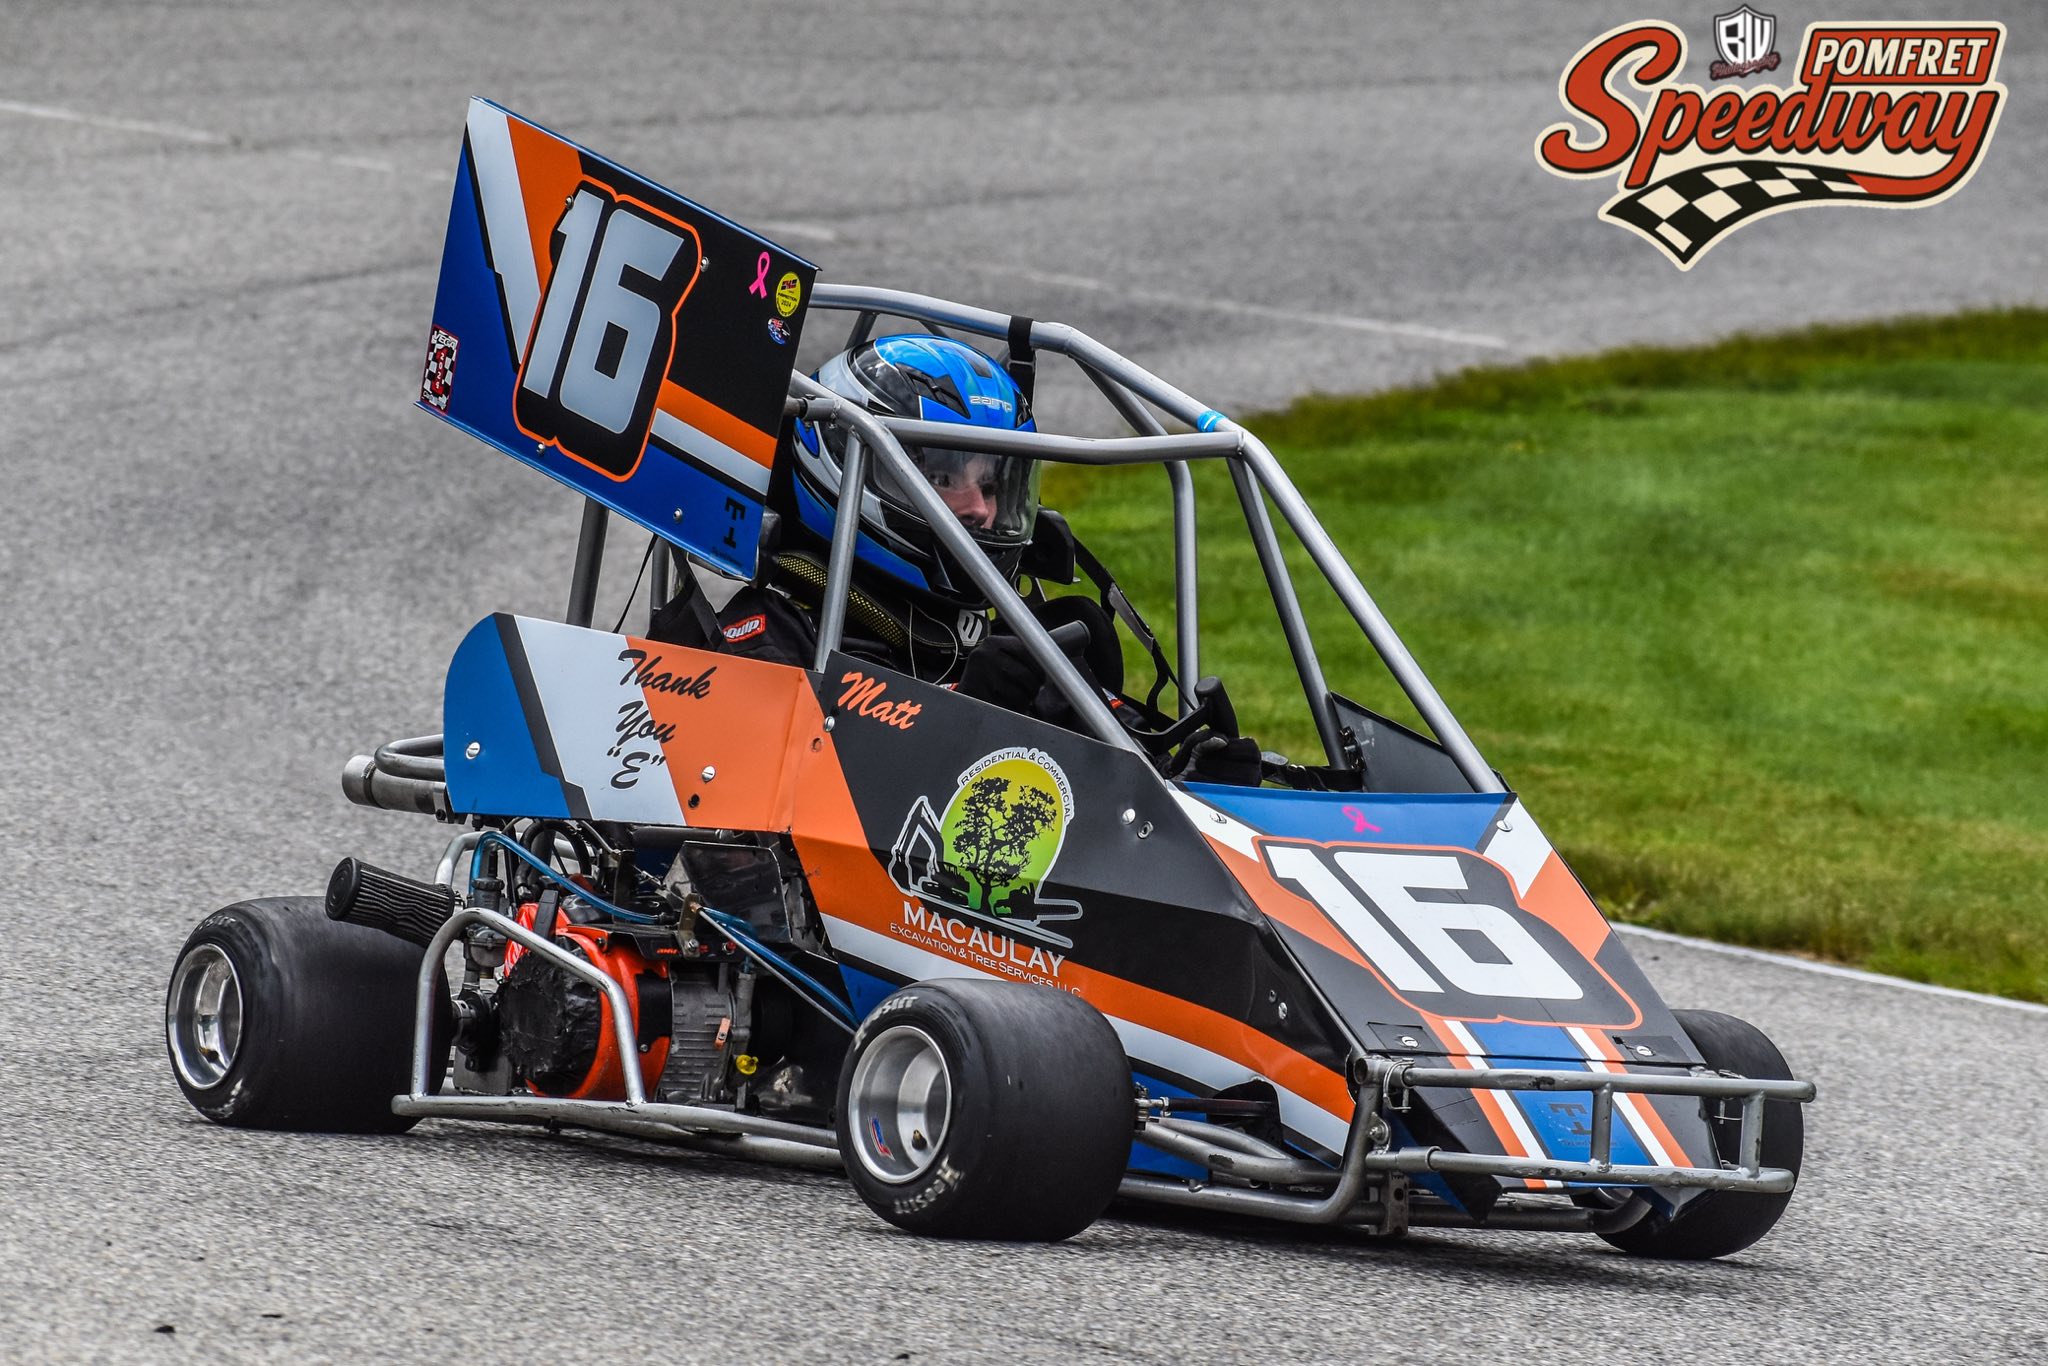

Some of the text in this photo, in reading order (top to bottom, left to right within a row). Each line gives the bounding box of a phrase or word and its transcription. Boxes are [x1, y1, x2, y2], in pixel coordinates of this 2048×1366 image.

[433, 329, 458, 350] VEGA
[522, 188, 685, 435] 16
[617, 649, 717, 700] Thank
[837, 671, 922, 730] Matt
[615, 700, 676, 747] You
[960, 751, 1071, 818] RESIDENTIAL & COMMERCIAL
[889, 922, 958, 956] EXCAVATION
[958, 947, 967, 959] &
[967, 949, 998, 970] TREE
[998, 961, 1054, 988] SERVICES
[903, 900, 1065, 978] MACAULAY
[1264, 845, 1584, 1000] 16
